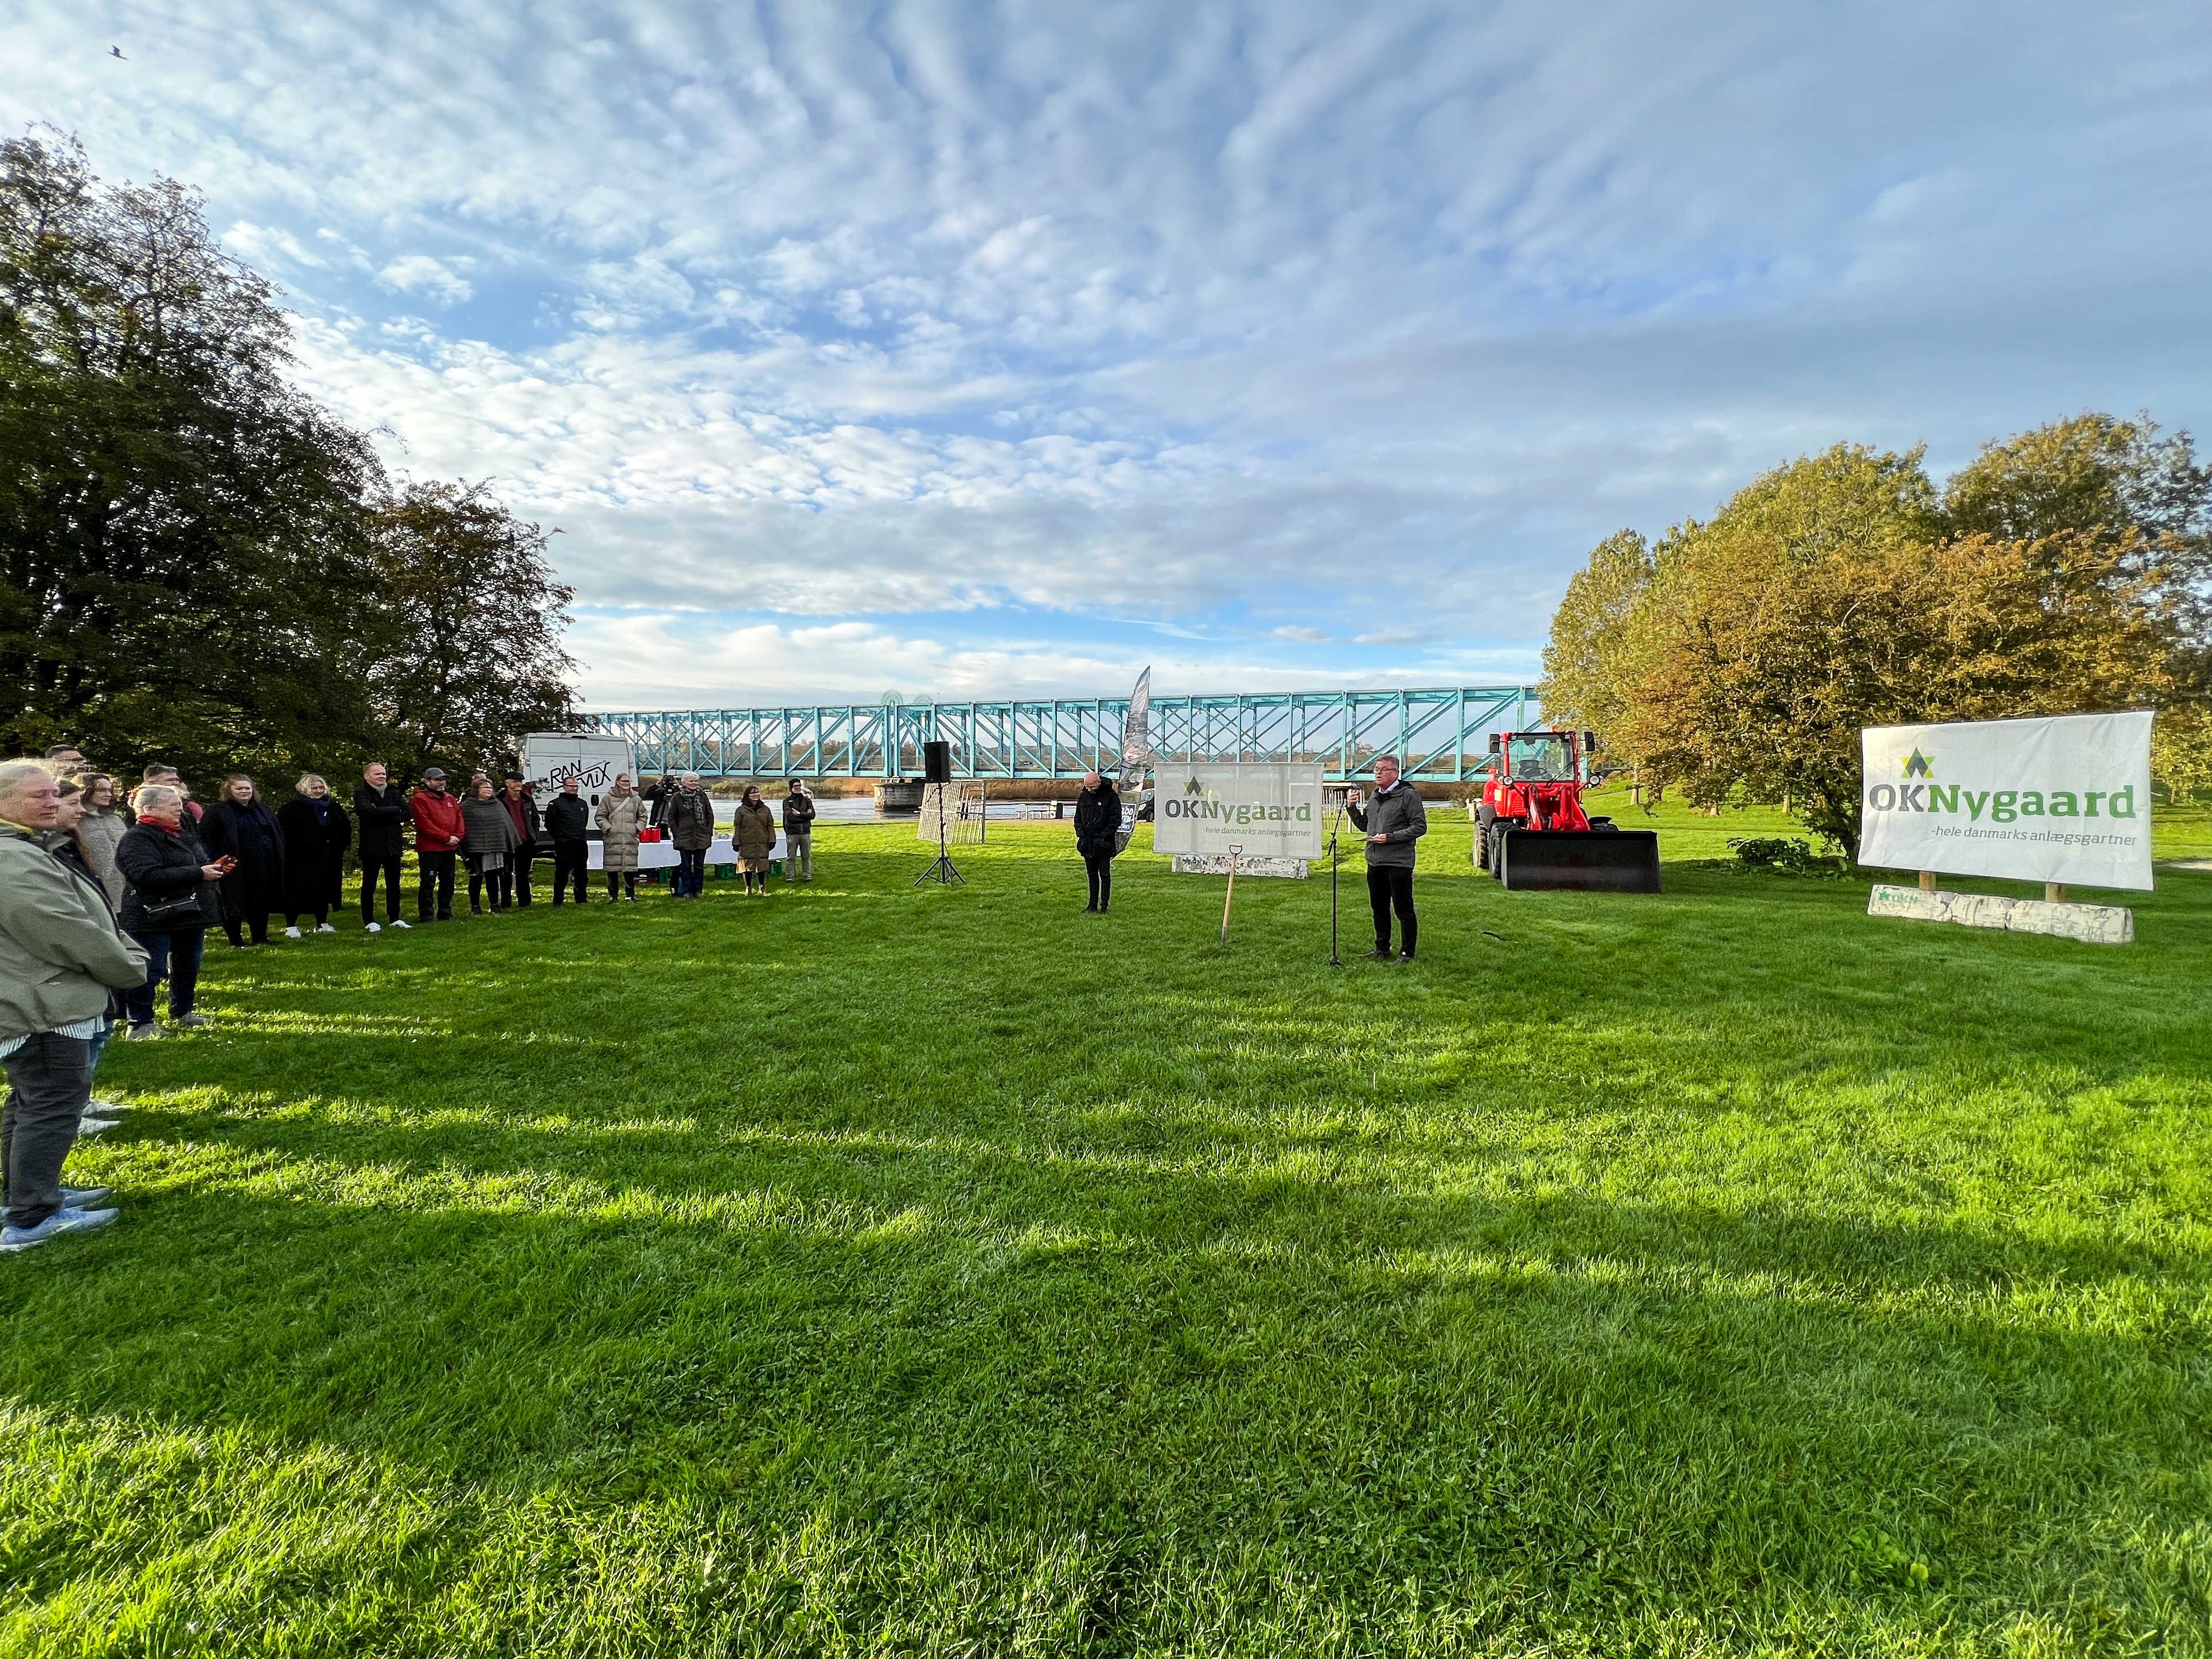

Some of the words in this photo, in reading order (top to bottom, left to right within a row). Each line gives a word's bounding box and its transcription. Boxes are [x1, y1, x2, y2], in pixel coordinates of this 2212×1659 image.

[1165, 799, 1311, 825] OKNygaard
[1870, 784, 2137, 823] OKNygaard
[1221, 827, 1256, 835] danmarks
[1257, 829, 1311, 837] anlægsgartner
[1964, 827, 2027, 841] danmarks
[2030, 829, 2137, 846] anlægsgartner
